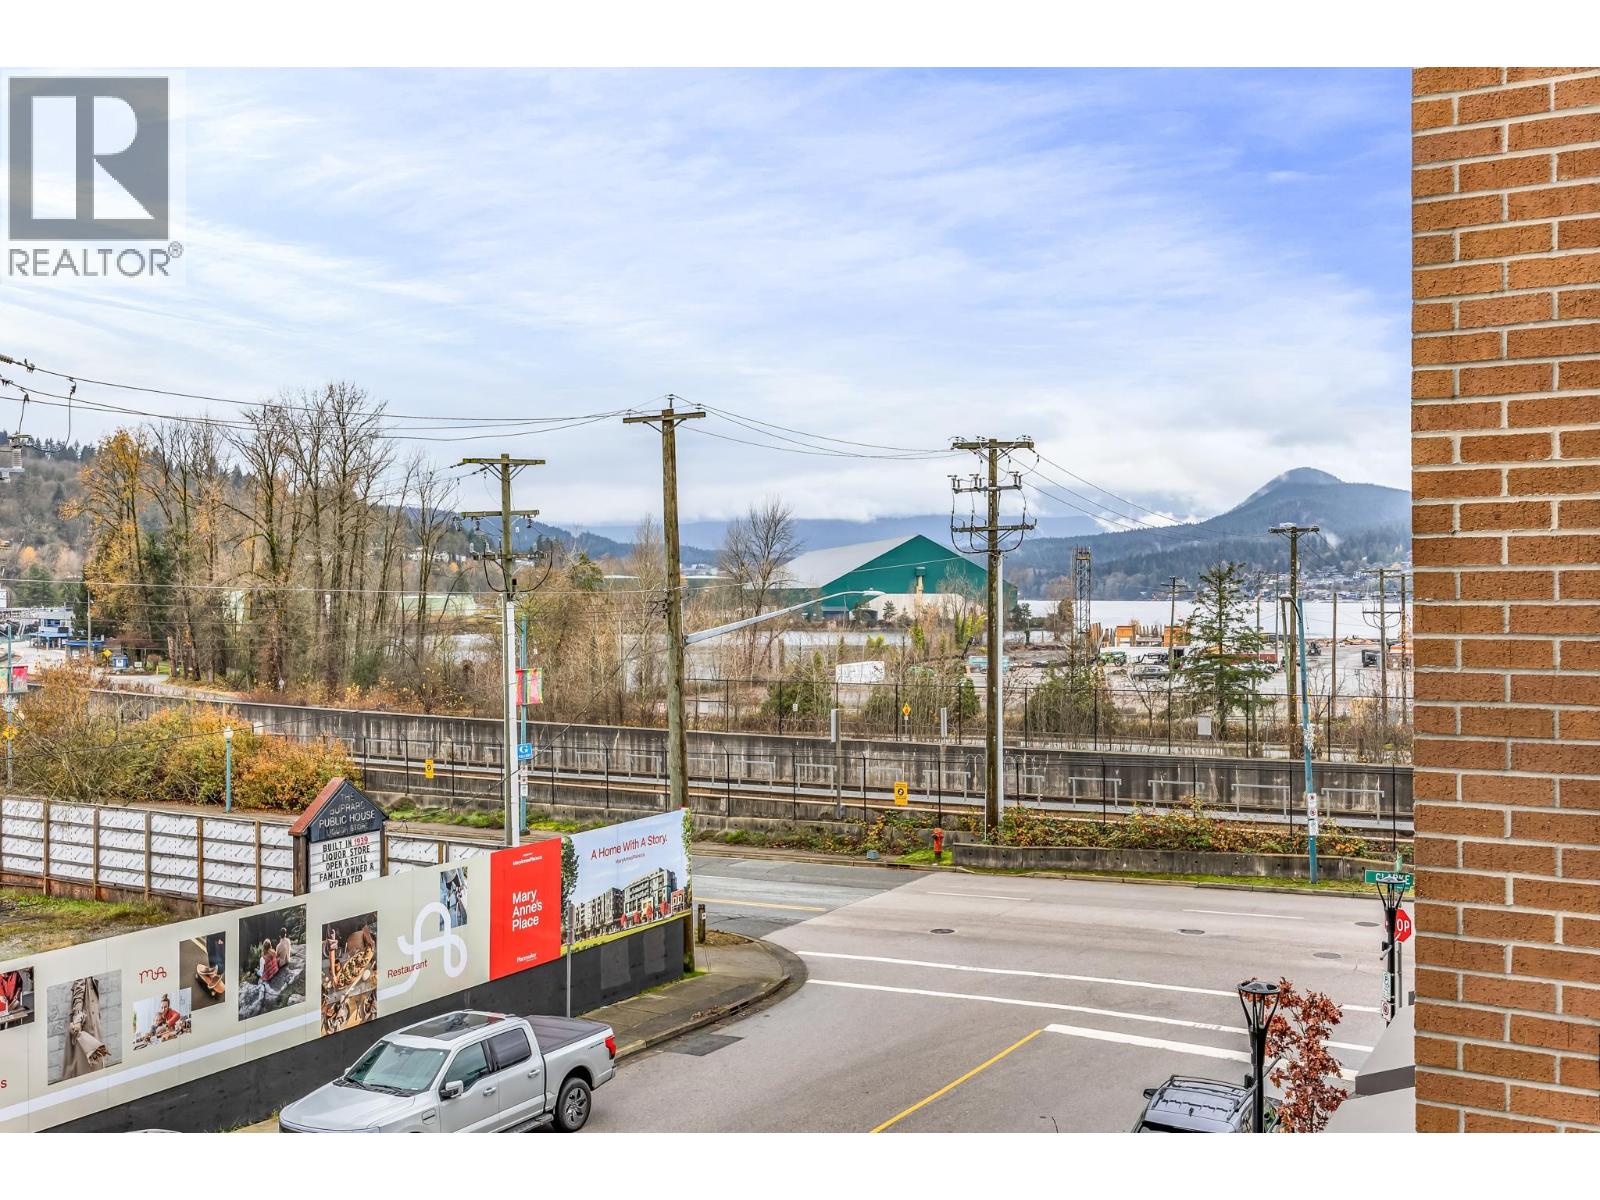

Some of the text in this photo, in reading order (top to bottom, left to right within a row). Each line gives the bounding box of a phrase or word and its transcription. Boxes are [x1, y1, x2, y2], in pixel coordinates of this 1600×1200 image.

[319, 810, 375, 828] PUBLIC HOUSE
[322, 841, 342, 853] BUILT
[345, 839, 352, 848] IN
[322, 845, 370, 862] LIQUOR STORE
[591, 834, 668, 860] A Home With A Story.
[325, 855, 368, 871] OPEN & STILL
[319, 862, 375, 882] FAMILY OWNED &
[329, 874, 363, 888] OPERATED
[512, 889, 537, 905] Mary
[512, 900, 543, 918] Anne's
[512, 915, 539, 932] Place
[387, 959, 428, 979] Restaurant
